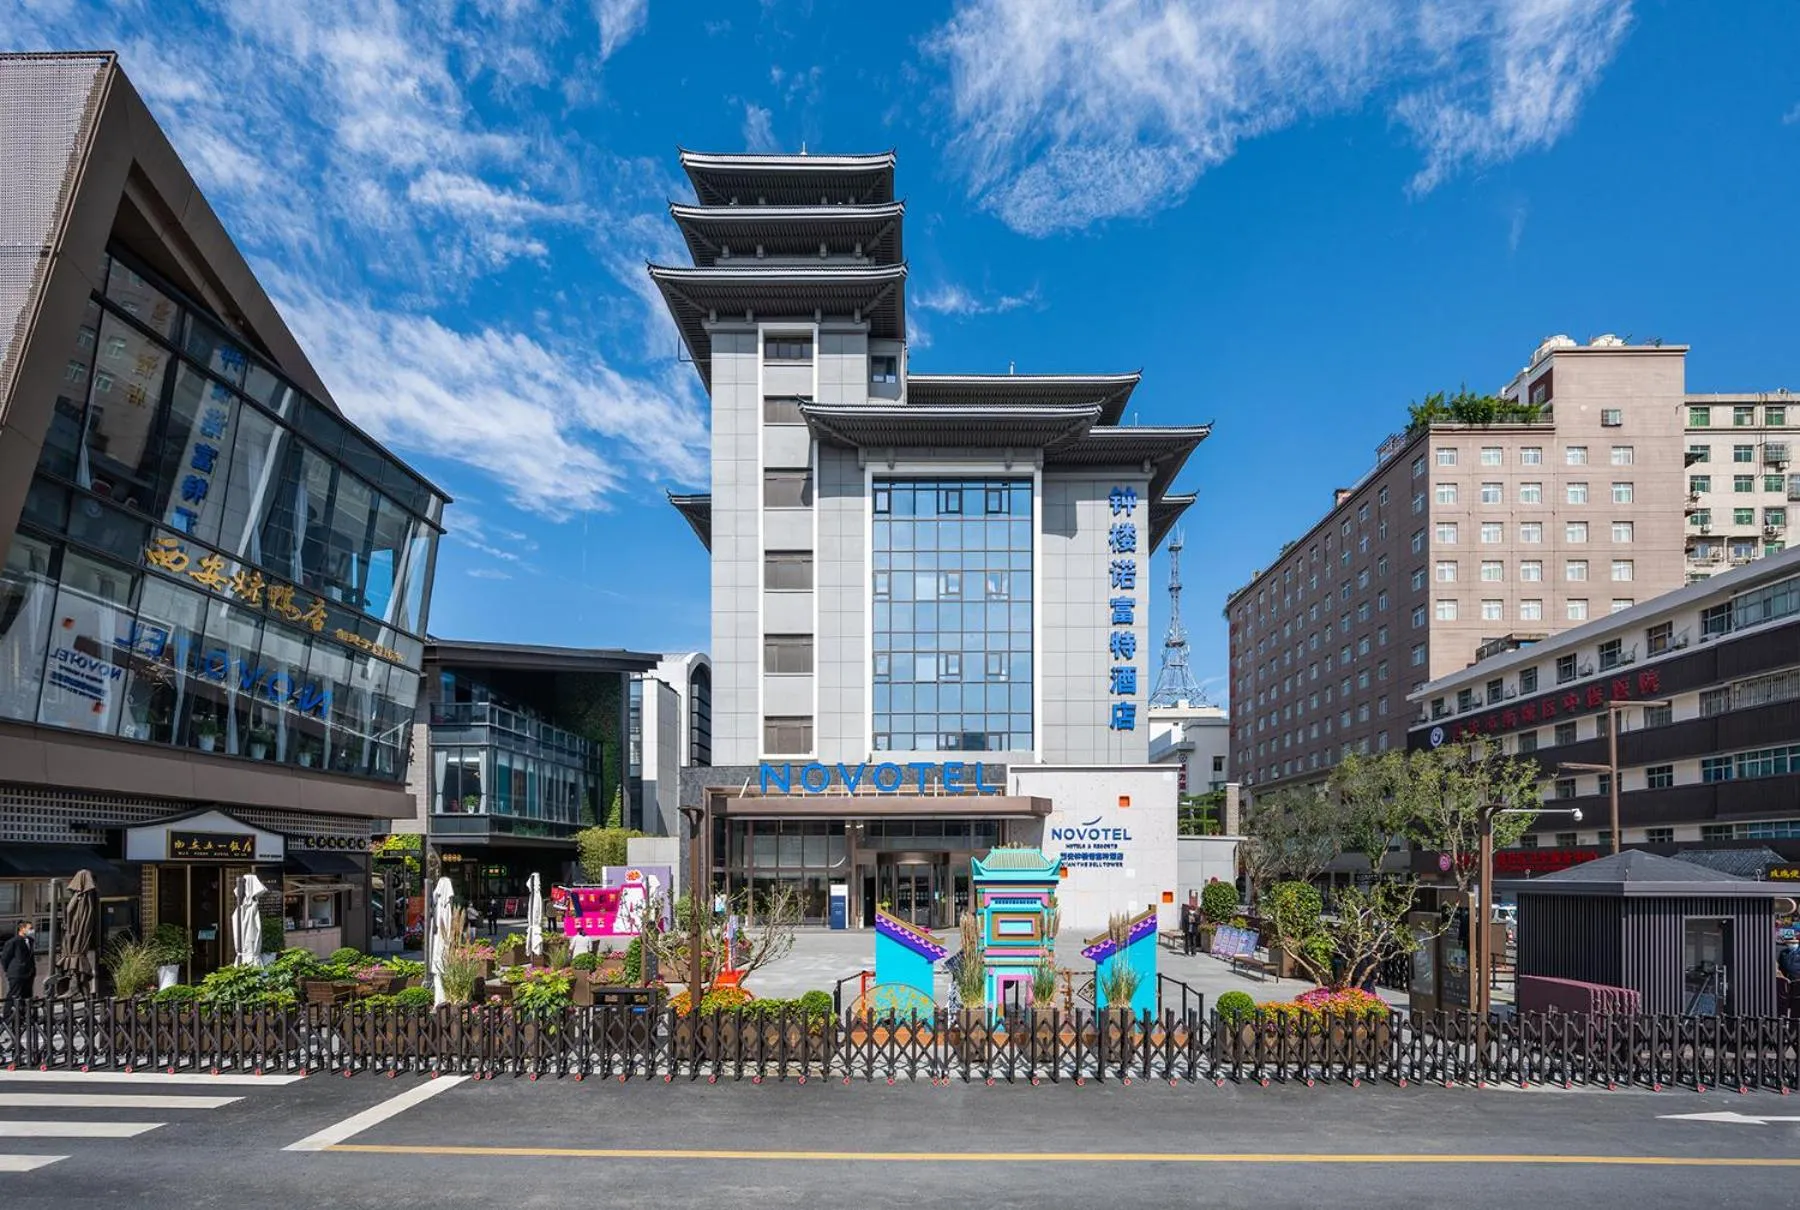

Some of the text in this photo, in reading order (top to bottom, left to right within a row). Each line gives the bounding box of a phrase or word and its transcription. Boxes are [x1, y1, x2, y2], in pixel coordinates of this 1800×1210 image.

[1109, 486, 1137, 731] 钟楼诺富特酒店
[760, 761, 997, 797] NOVOTEL
[1051, 828, 1132, 841] NOVOTEL
